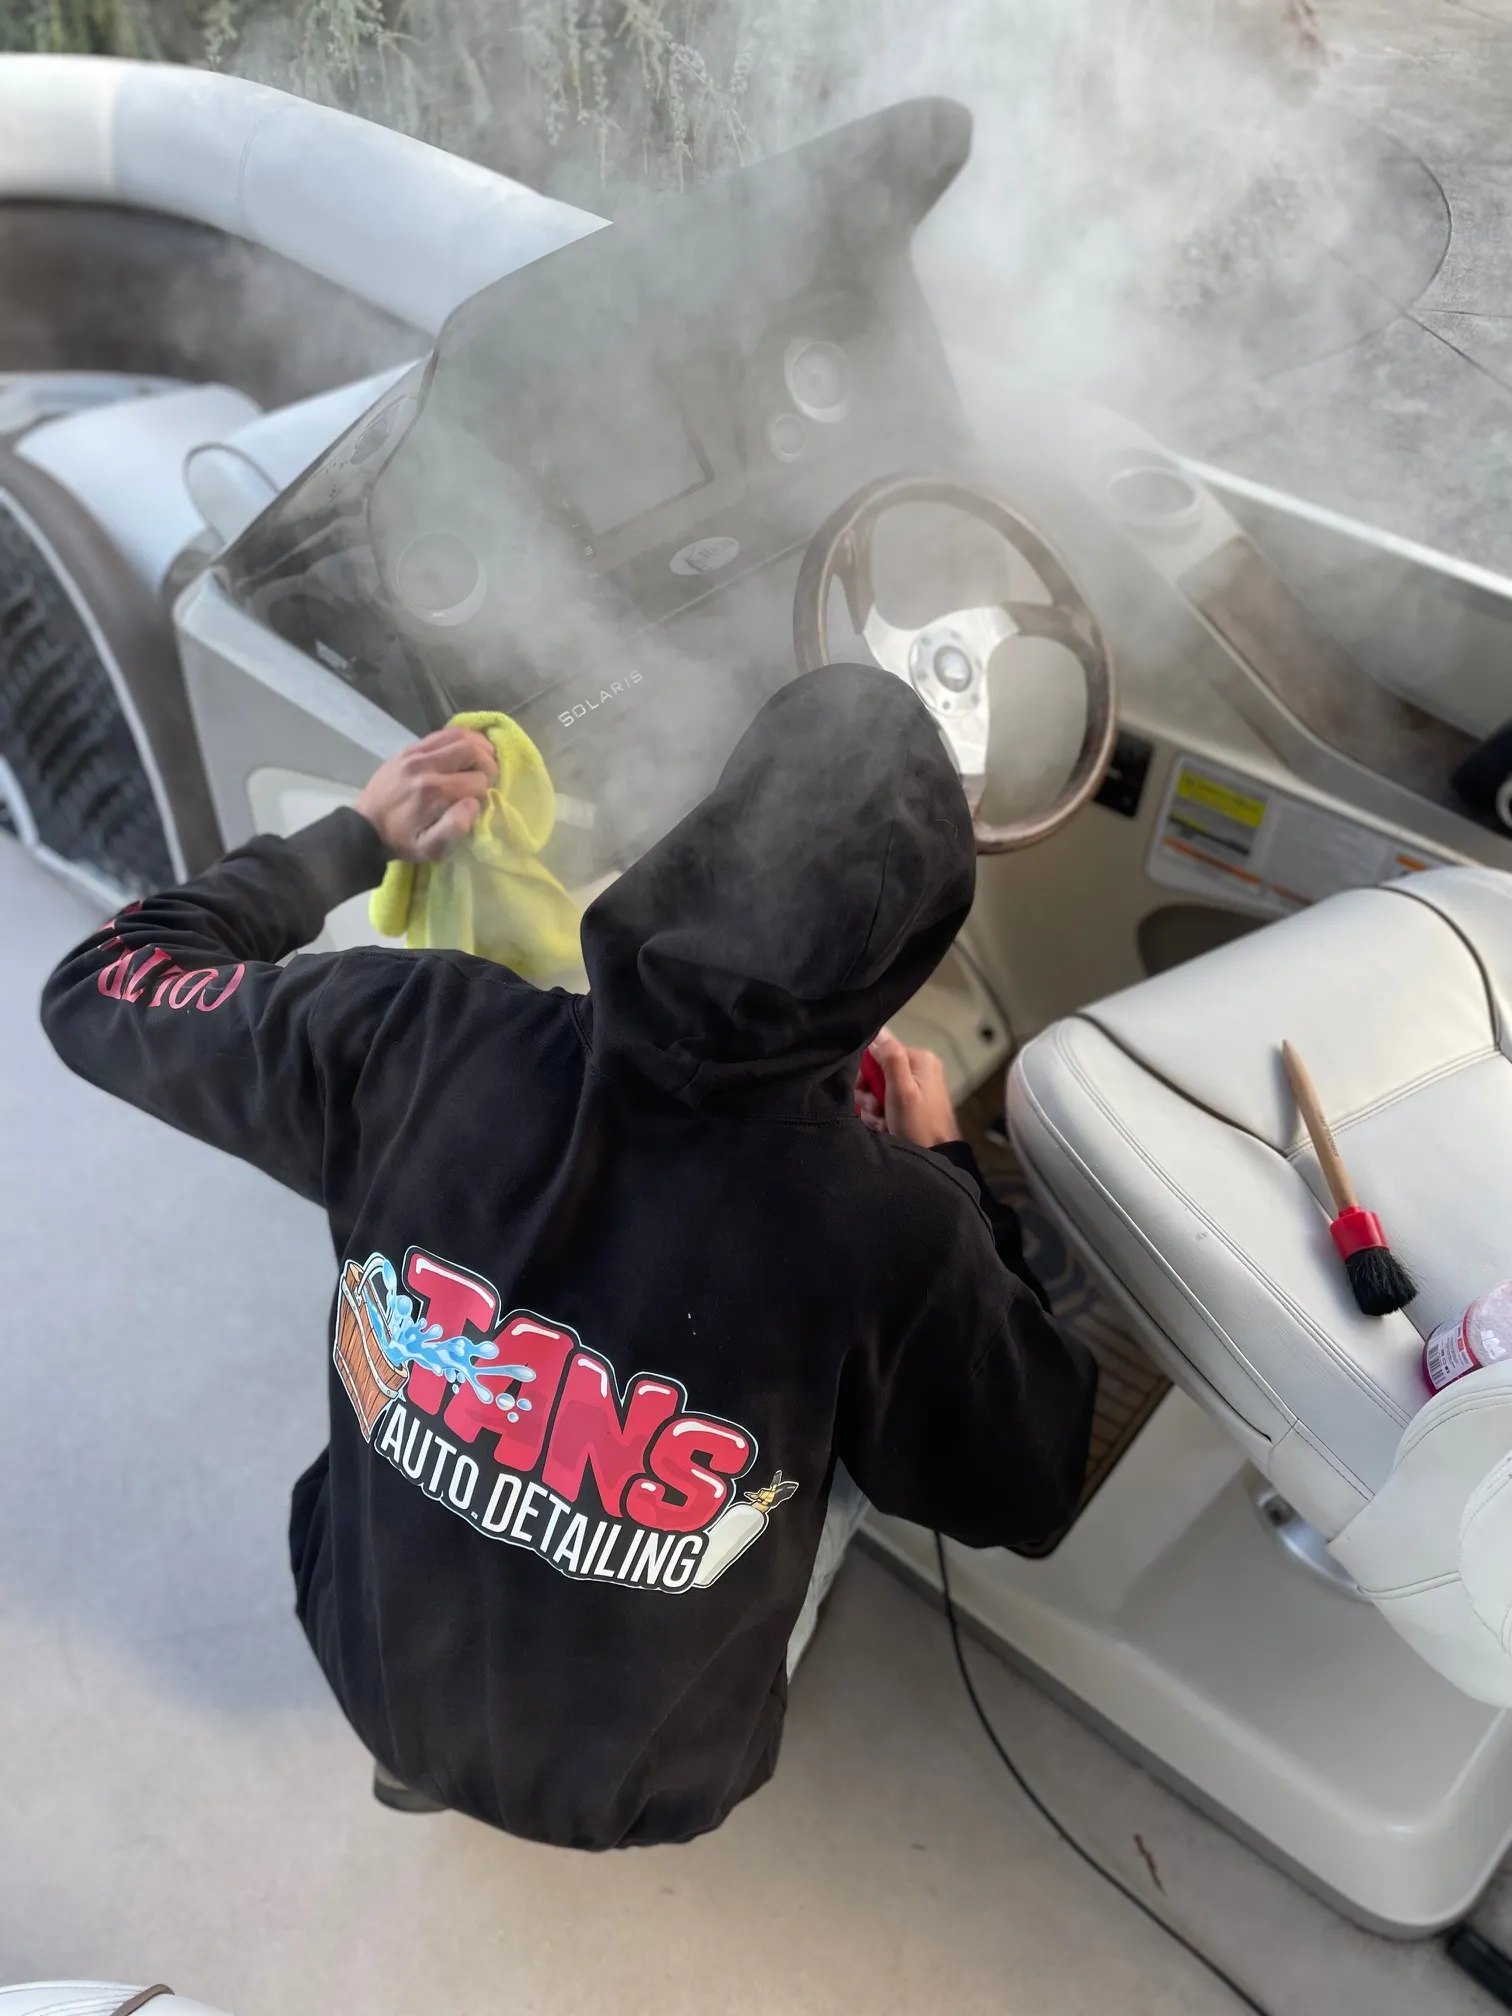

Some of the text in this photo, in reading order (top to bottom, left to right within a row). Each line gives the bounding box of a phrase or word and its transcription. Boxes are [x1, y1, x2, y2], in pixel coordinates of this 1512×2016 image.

[557, 670, 643, 727] SOLARIS
[404, 1249, 752, 1533] TANS
[380, 1403, 703, 1588] AUTO DETAILING
